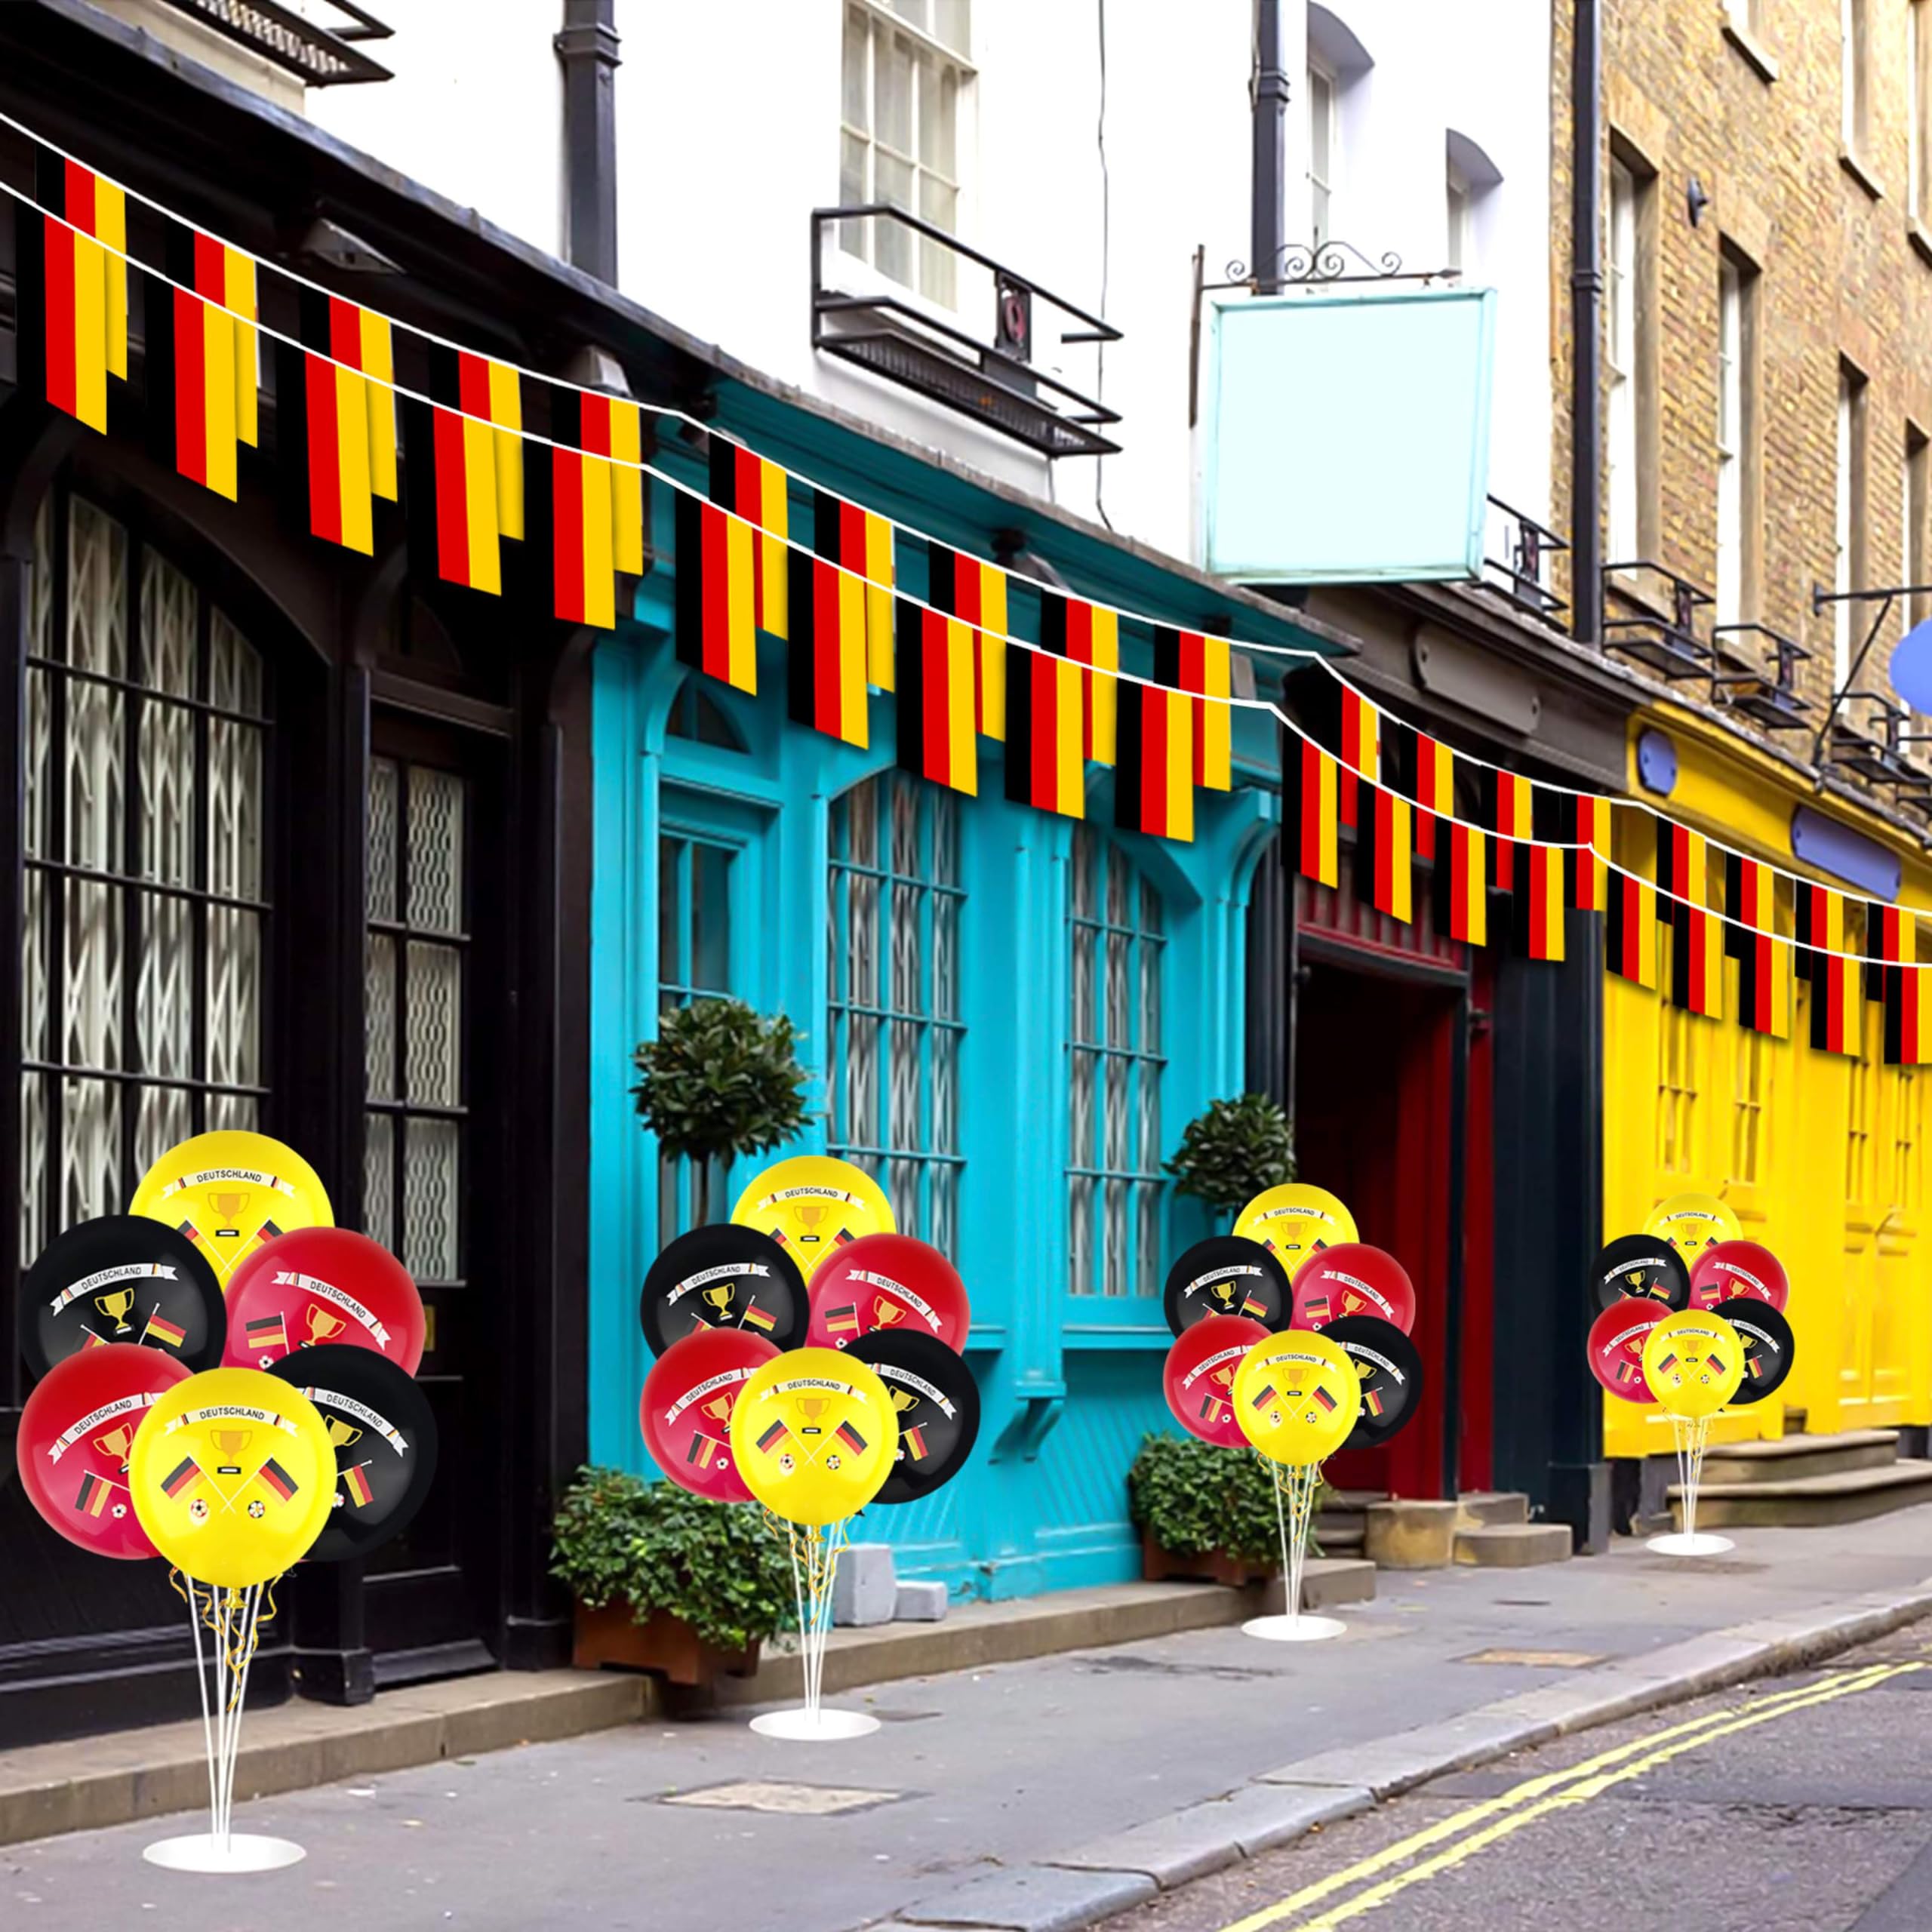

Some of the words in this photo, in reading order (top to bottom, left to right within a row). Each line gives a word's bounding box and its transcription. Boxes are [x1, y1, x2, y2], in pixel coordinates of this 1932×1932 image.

[196, 1170, 261, 1182] DEUTSCHLAND
[785, 1188, 838, 1198] DEUTSCHLAND
[82, 1266, 142, 1291] DEUTSCHLAND
[691, 1265, 741, 1284] DEUTSCHLAND
[1203, 1266, 1241, 1281] DEUTSCHLAND
[877, 1277, 922, 1309] DEUTSCHLAND
[1343, 1276, 1379, 1300] DEUTSCHLAND
[309, 1281, 367, 1319] DEUTSCHLAND
[1199, 1350, 1234, 1371] DEUTSCHLAND
[1355, 1346, 1389, 1367] DEUTSCHLAND
[686, 1374, 733, 1401] DEUTSCHLAND
[788, 1380, 841, 1390] DEUTSCHLAND
[890, 1368, 936, 1397] DEUTSCHLAND
[74, 1399, 133, 1434] DEUTSCHLAND
[199, 1407, 265, 1420] DEUTSCHLAND
[326, 1393, 383, 1428] DEUTSCHLAND
